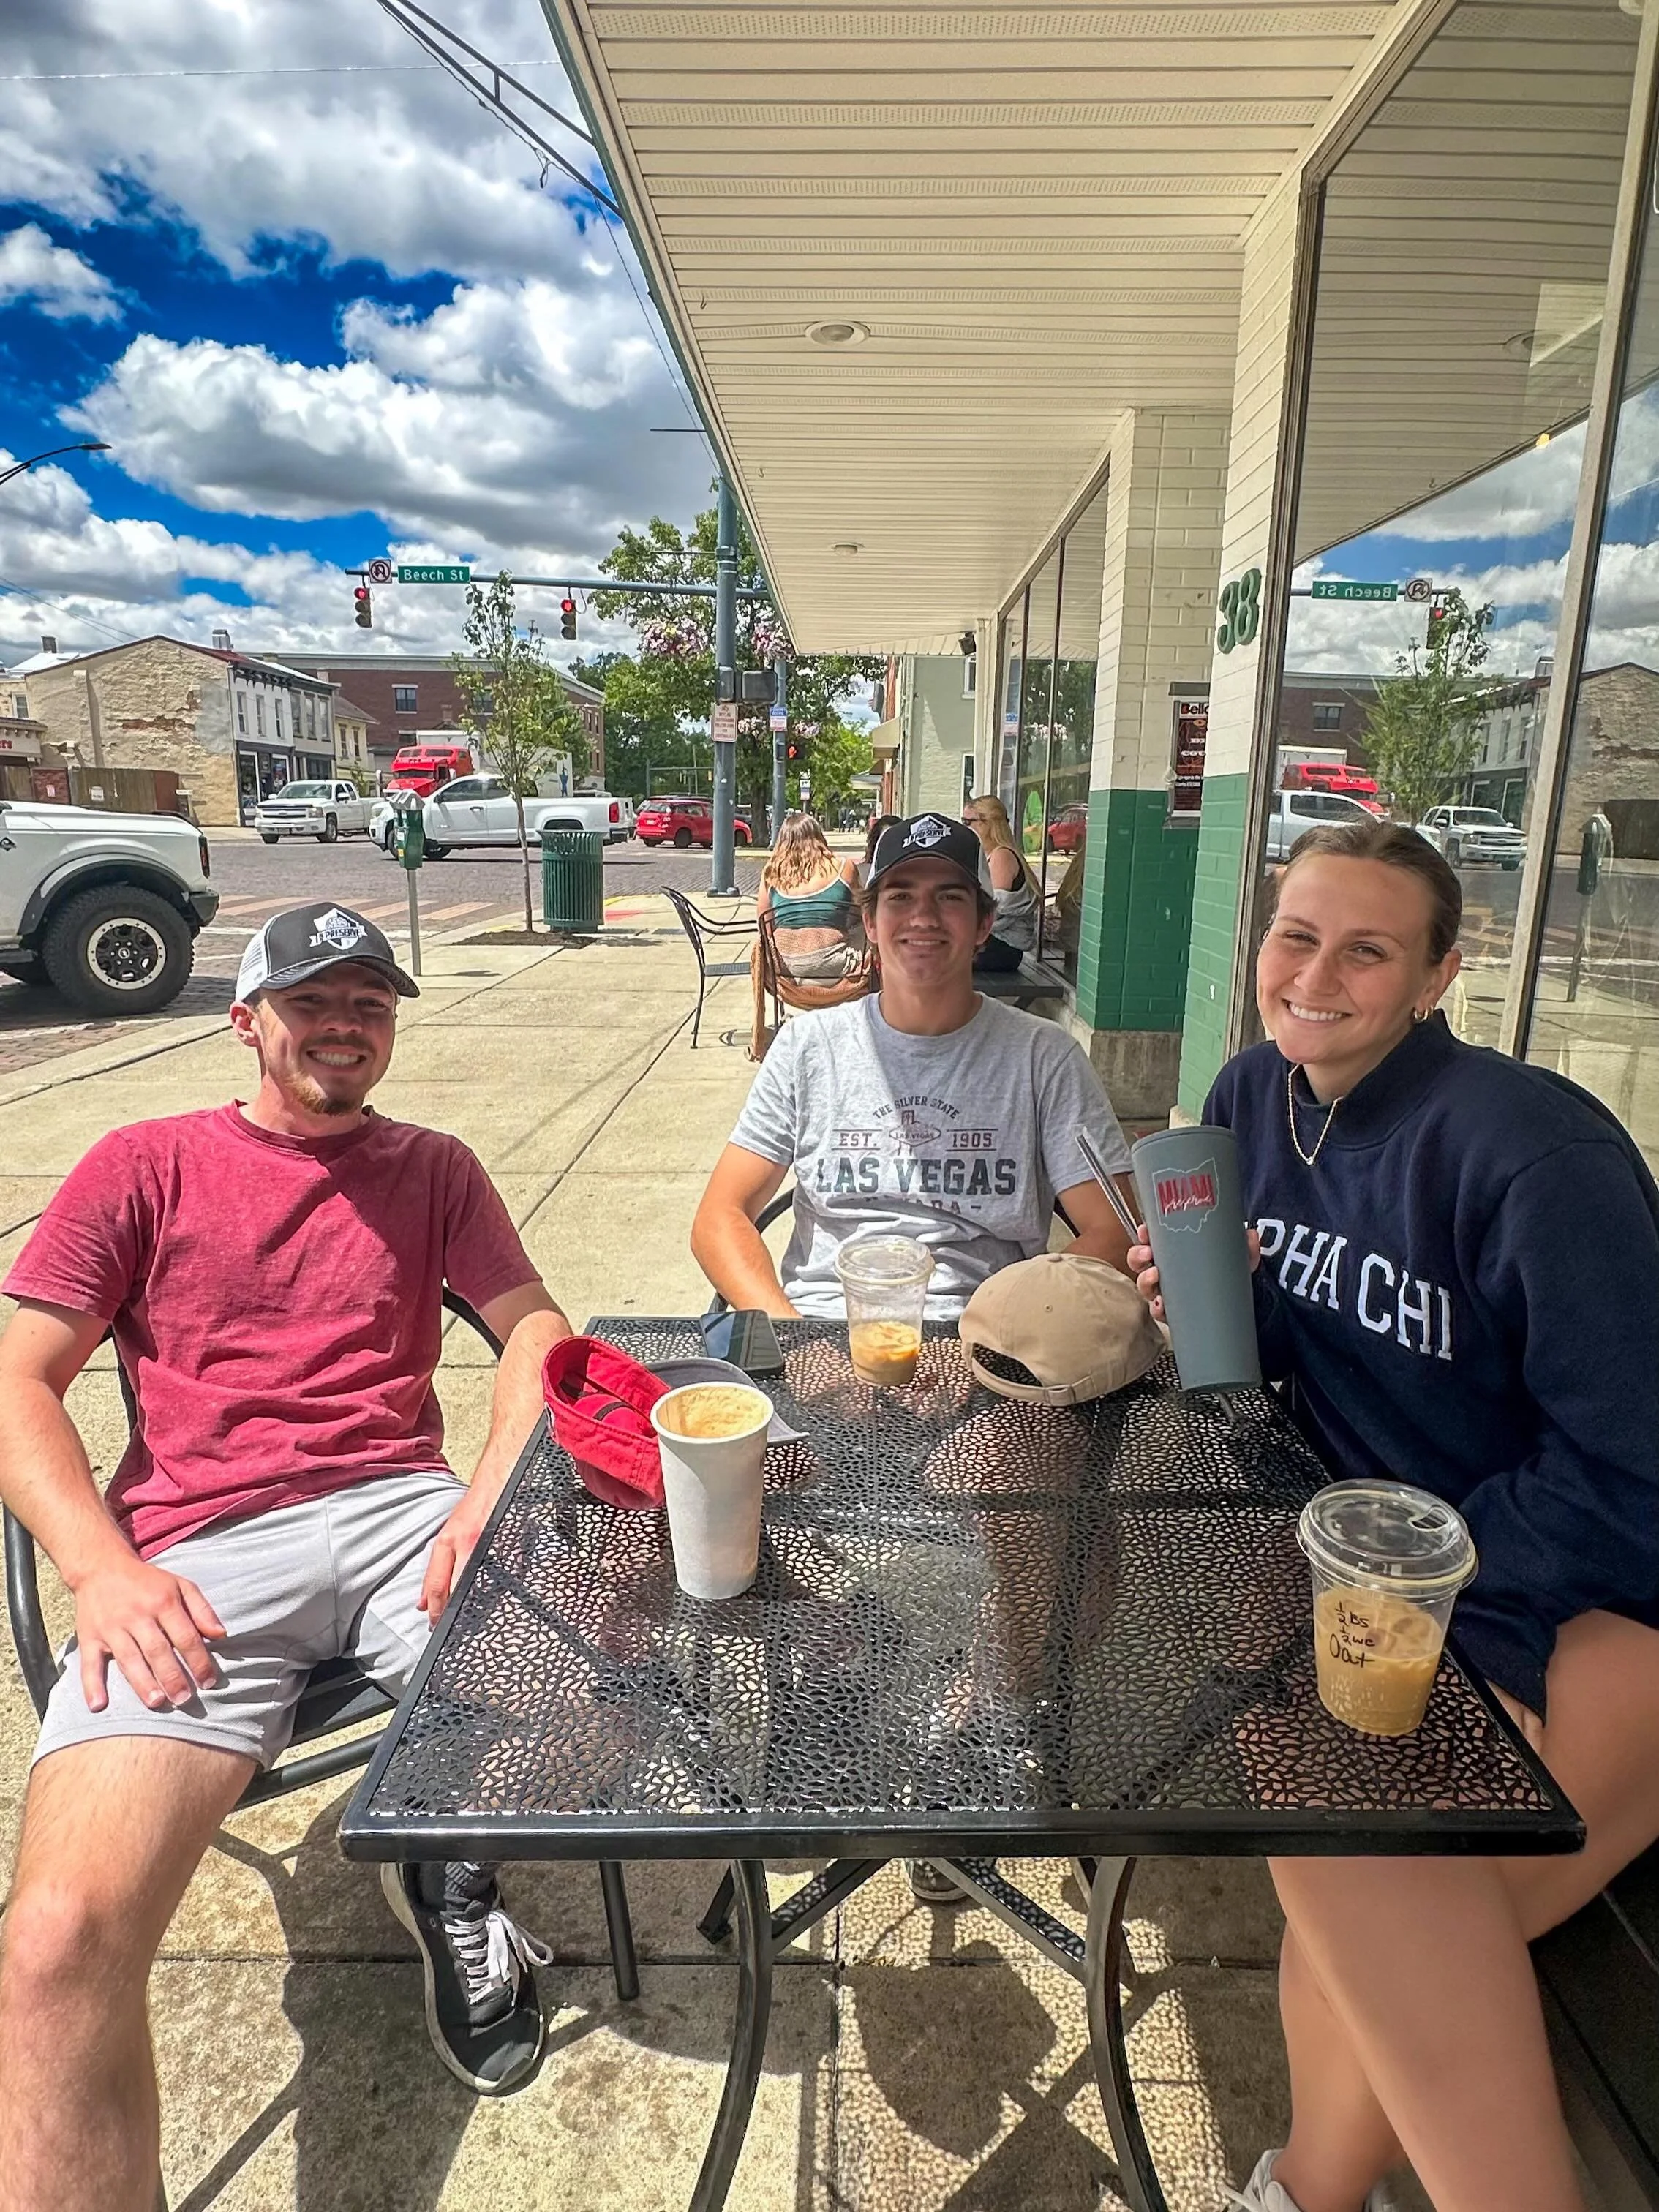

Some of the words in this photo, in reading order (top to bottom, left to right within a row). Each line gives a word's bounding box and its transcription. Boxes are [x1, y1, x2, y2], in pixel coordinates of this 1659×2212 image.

[404, 569, 444, 581] Beech
[450, 569, 464, 581] St
[1217, 568, 1262, 654] 38
[873, 1104, 893, 1119] THE
[895, 1096, 928, 1110] SILVER
[930, 1098, 960, 1119] STATE
[839, 1133, 878, 1147] EST.
[952, 1132, 993, 1148] 1905
[816, 1157, 880, 1194] LAS
[893, 1158, 1016, 1195] VEGAS
[1244, 1219, 1347, 1310] PHA
[1358, 1253, 1452, 1361] CHI
